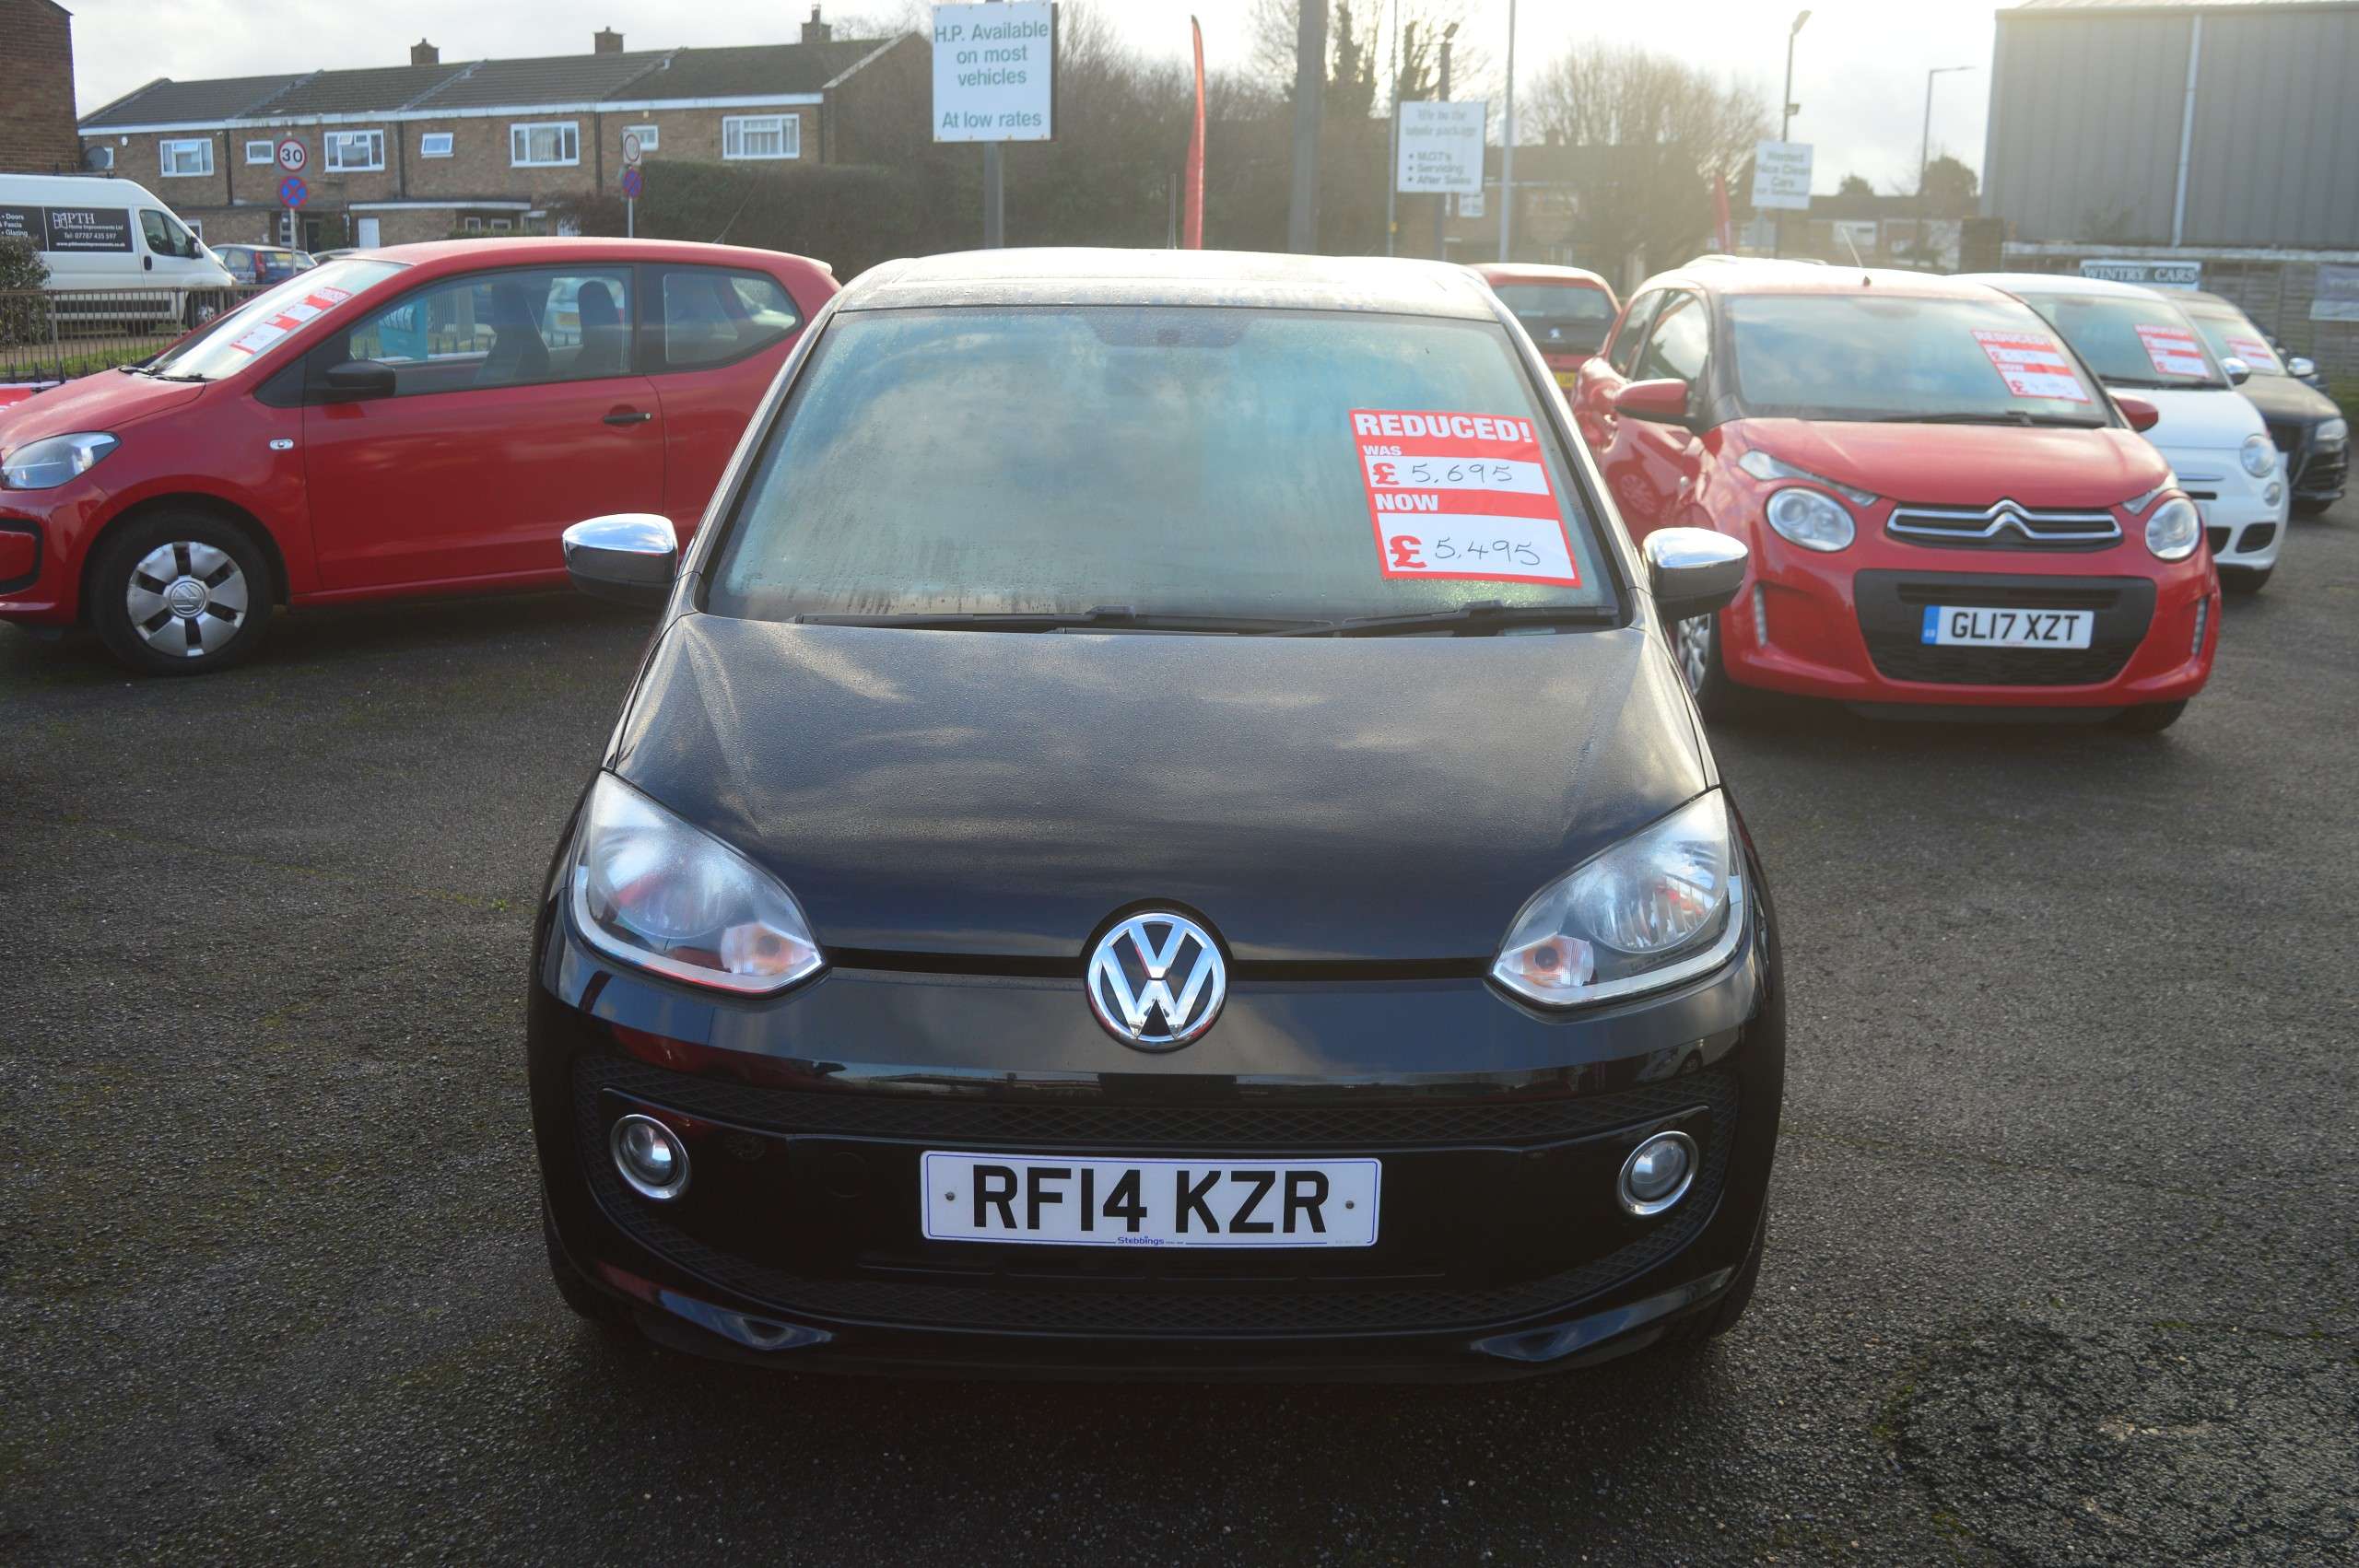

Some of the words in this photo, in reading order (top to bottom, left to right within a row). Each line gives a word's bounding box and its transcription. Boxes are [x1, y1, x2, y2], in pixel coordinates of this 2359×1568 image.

[934, 24, 966, 42] H.P.
[971, 20, 1049, 41] Available
[957, 50, 978, 64] on
[983, 44, 1027, 63] most
[957, 67, 1027, 87] vehicles
[942, 111, 959, 128] At
[963, 111, 992, 128] low
[998, 110, 1042, 127] rates
[281, 147, 303, 163] 30
[67, 212, 96, 224] PTH
[2083, 266, 2147, 281] WINTRY
[2154, 267, 2197, 283] CARS
[1354, 413, 1534, 443] REDUCED!
[1363, 445, 1402, 457] WAS
[1372, 462, 1401, 486] £
[1374, 493, 1439, 511] NOW
[1389, 534, 1428, 569] £
[1951, 612, 2017, 639] GL17
[2024, 614, 2080, 641] XZT
[972, 1164, 1148, 1233] RF14
[1175, 1169, 1330, 1235] KZR
[1117, 1235, 1165, 1246] Stebbings
